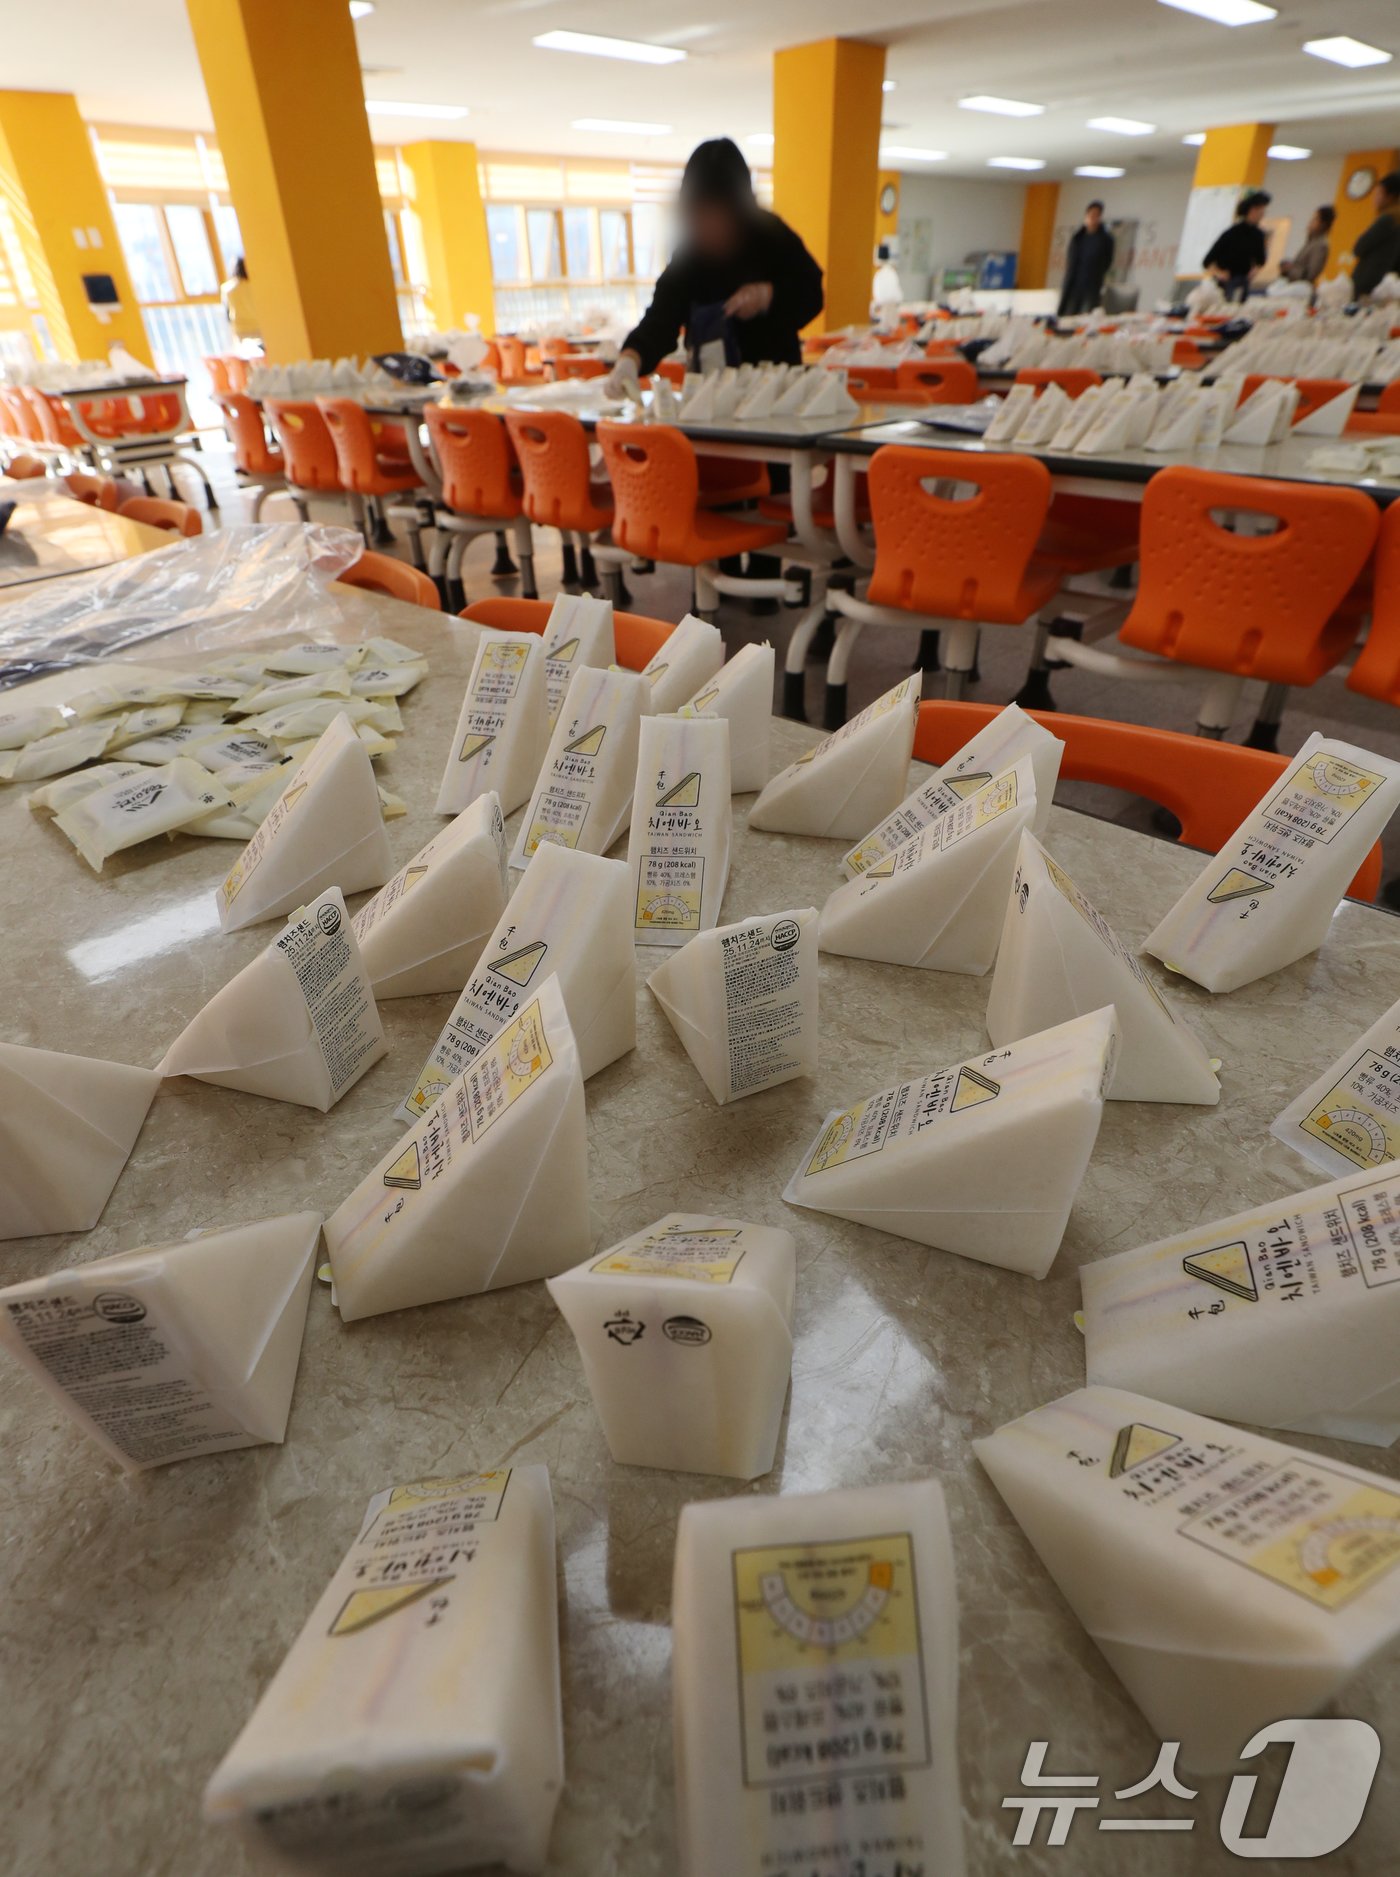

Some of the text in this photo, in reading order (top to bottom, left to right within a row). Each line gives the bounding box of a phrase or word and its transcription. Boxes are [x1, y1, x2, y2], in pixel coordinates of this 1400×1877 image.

[546, 669, 570, 679] 엔바오
[553, 760, 596, 778] 치엔바오
[656, 770, 667, 790] 千包
[923, 787, 949, 813] 치엔바
[648, 817, 702, 831] 치엔바오
[1275, 807, 1293, 821] kcal)
[1292, 816, 1310, 828] (208
[1264, 821, 1315, 849] 햄치즈 샌드위치
[1316, 827, 1327, 836] 78
[651, 846, 697, 855] 햄치즈 샌드위치
[1241, 842, 1298, 878] 치엔바오
[1248, 836, 1305, 864] TAIWAN SANDWICH
[680, 861, 696, 869] kcal)
[1243, 860, 1277, 879] Qian Bao
[322, 910, 337, 926] HACCP
[1240, 899, 1259, 919] 千包
[277, 919, 311, 949] 햄치즈샌드
[500, 925, 516, 951] 千包
[721, 927, 764, 948] 햄치즈샌드
[775, 929, 796, 940] HACCP
[486, 976, 517, 997] Qian Bao
[463, 996, 482, 1011] TAIWAN
[456, 1016, 475, 1033] 햄치즈
[446, 1033, 456, 1042] 78
[461, 1041, 477, 1055] (208
[1369, 1061, 1390, 1079] 78 g
[943, 1075, 954, 1095] Qian
[1358, 1072, 1391, 1098] 빵류 40%,
[886, 1091, 895, 1101] 78
[918, 1069, 949, 1131] 치엔바오
[1350, 1081, 1399, 1114] 10%, 가공치즈
[477, 1118, 484, 1128] 78
[879, 1109, 890, 1125] (208
[872, 1125, 884, 1144] kcal)
[428, 1110, 444, 1180] 치엔바오
[1323, 1209, 1358, 1278] 햄치즈 샌드위치
[1352, 1200, 1387, 1271] 78 g (208 kcal)
[1267, 1219, 1303, 1300] 치엔바오
[1293, 1213, 1320, 1294] TAIWAN SANDWICH
[1258, 1241, 1275, 1290] Qian Bao
[1187, 1300, 1225, 1320] 千包
[1123, 1443, 1234, 1499] 치엔바오
